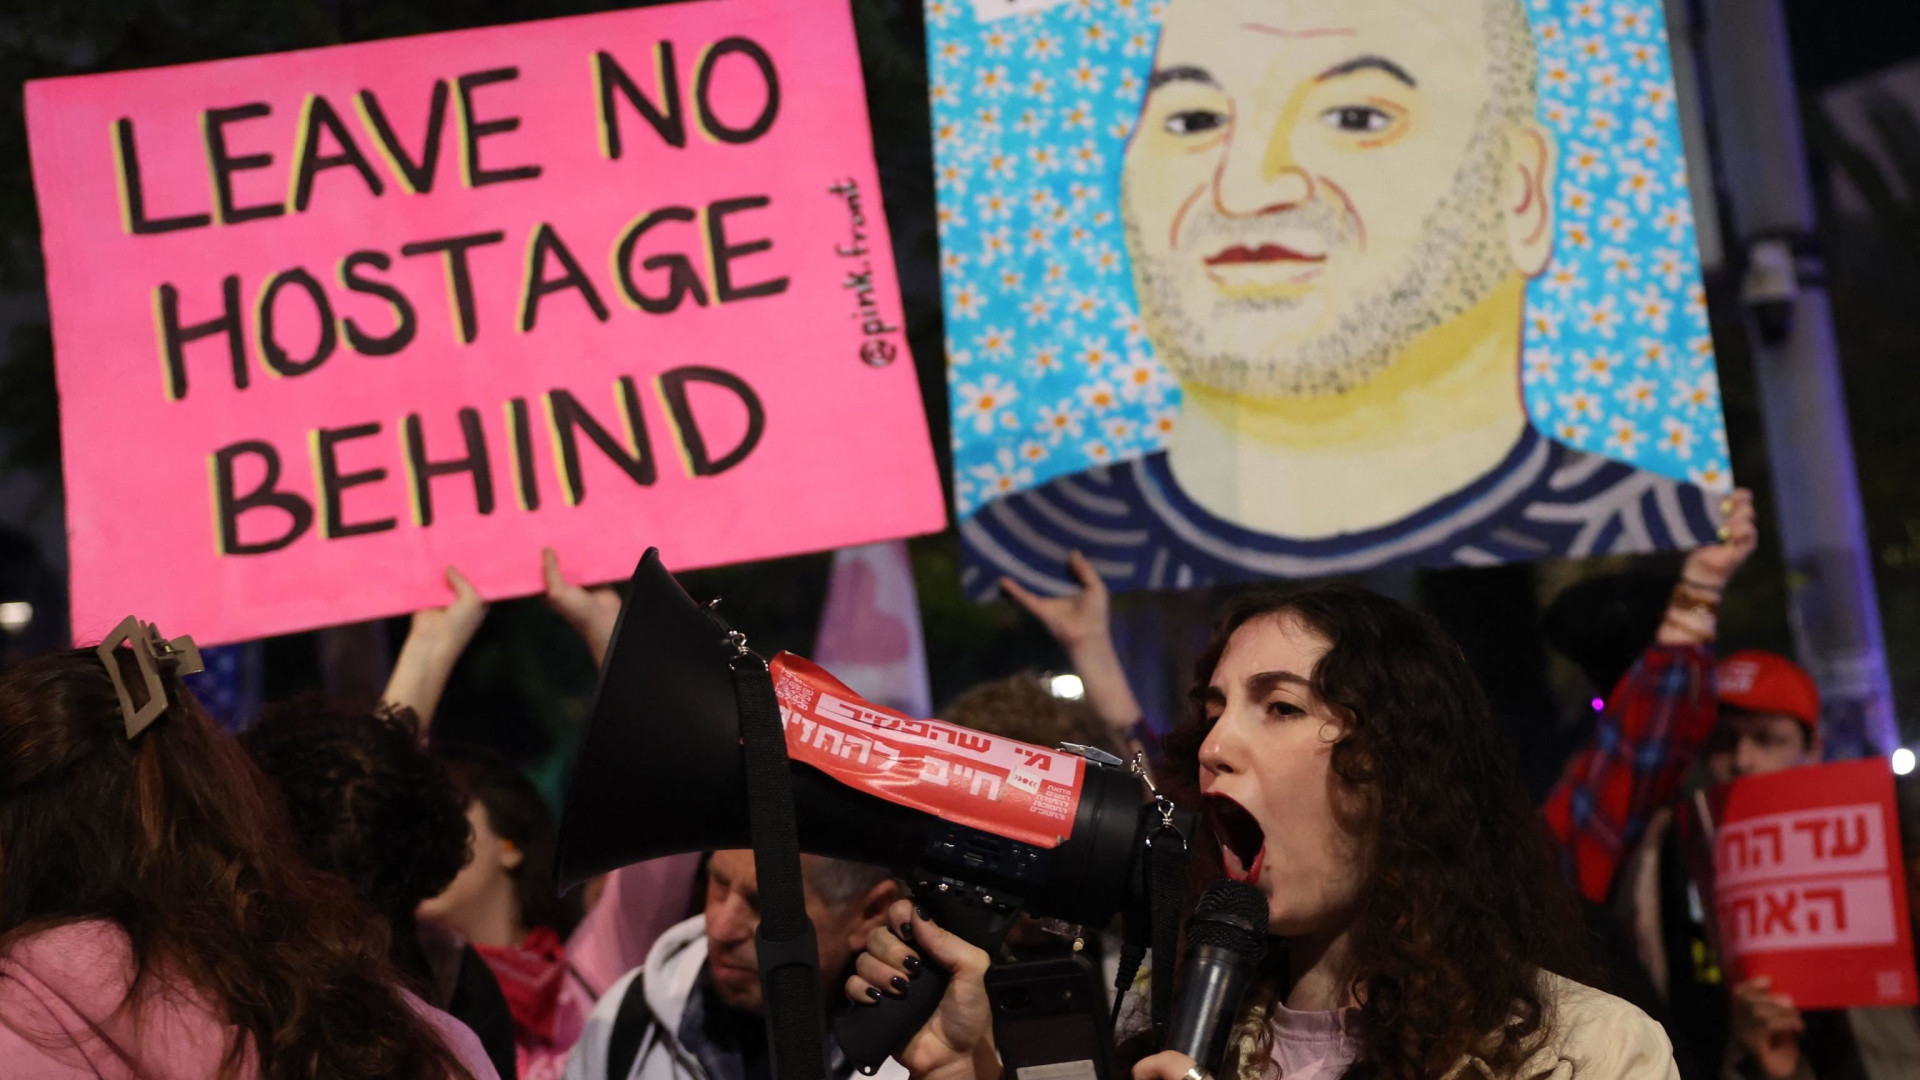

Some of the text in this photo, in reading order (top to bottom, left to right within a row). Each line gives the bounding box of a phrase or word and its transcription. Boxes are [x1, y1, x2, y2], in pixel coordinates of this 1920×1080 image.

[113, 37, 779, 234] LEAVE NO
[155, 197, 788, 400] HOSTAGE
[830, 177, 899, 368] @pink.front
[210, 366, 764, 555] BEHIND
[839, 703, 1052, 771] מי שהפקיר
[919, 755, 1002, 801] חייב
[1792, 814, 1868, 858] עד
[1721, 887, 1847, 942] האח
